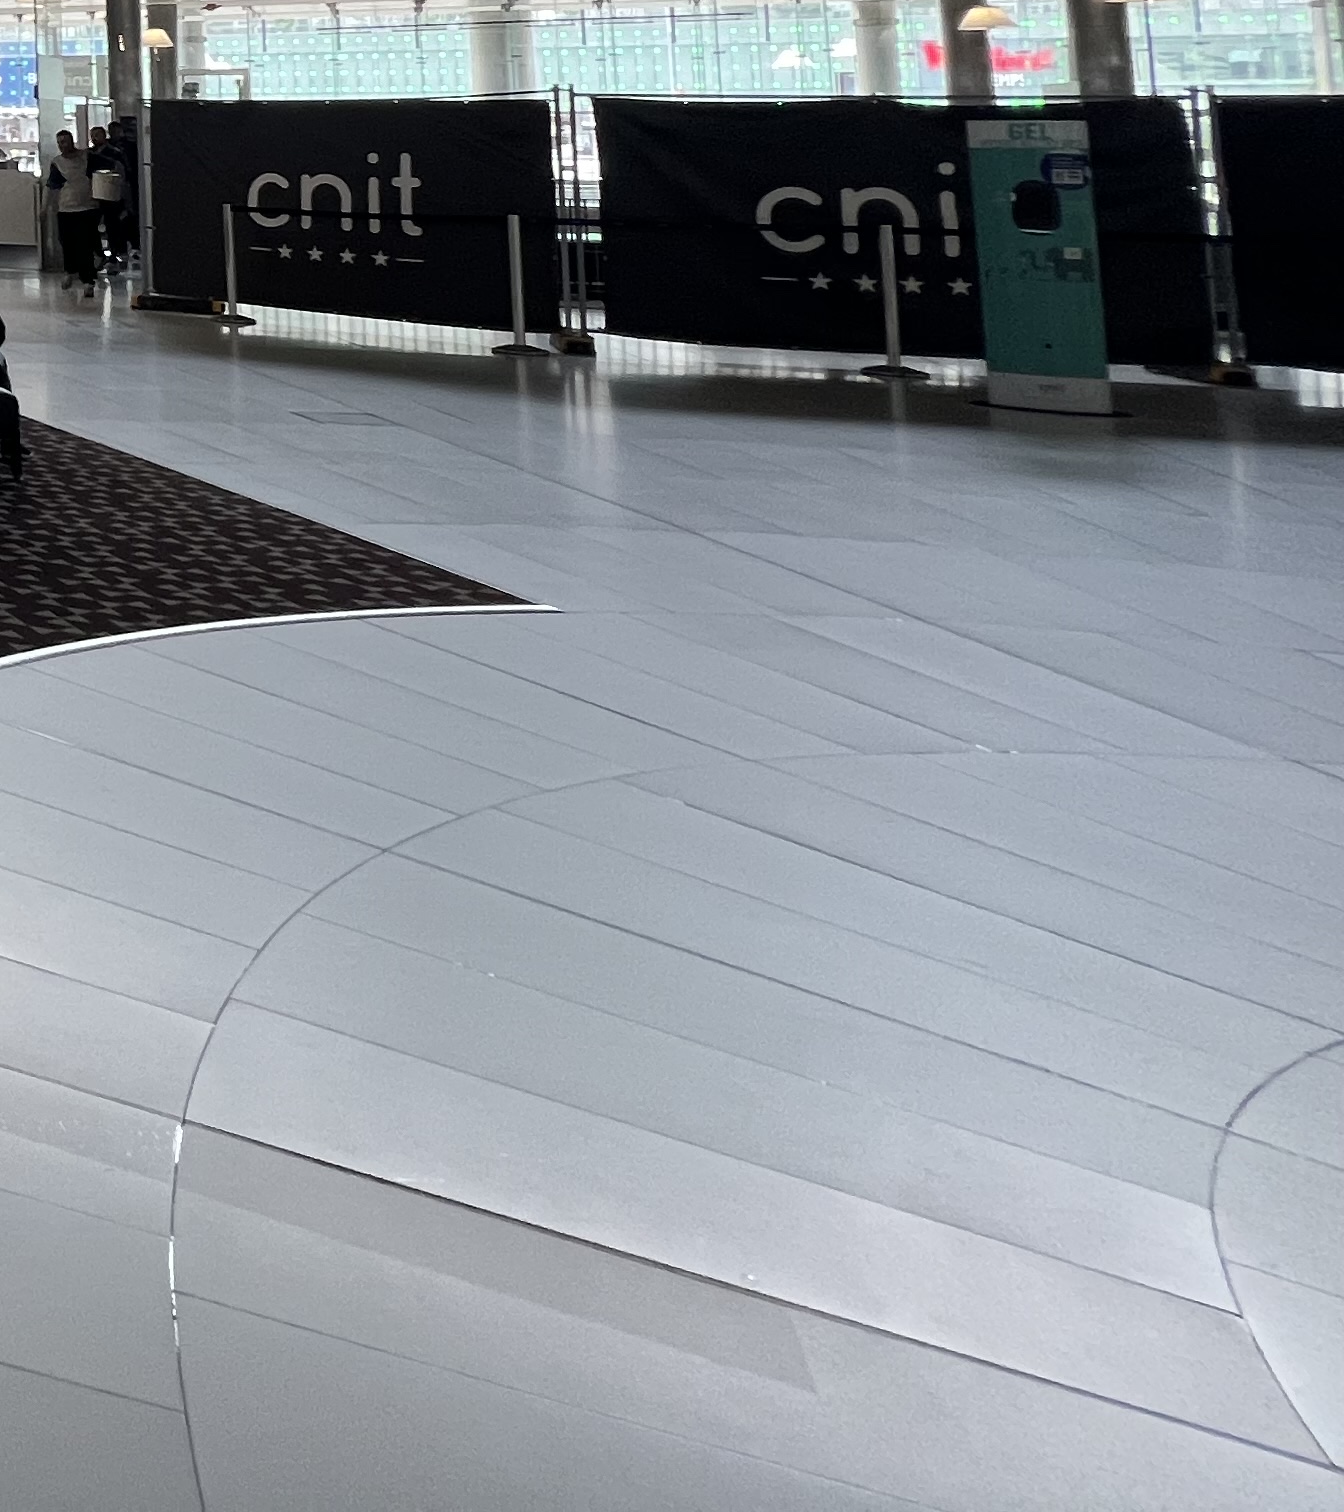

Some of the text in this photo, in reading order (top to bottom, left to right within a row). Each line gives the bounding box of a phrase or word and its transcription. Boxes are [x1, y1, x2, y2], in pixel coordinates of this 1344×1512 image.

[993, 73, 1025, 88] EMPS
[247, 152, 423, 236] cnit
[756, 161, 961, 258] cni
